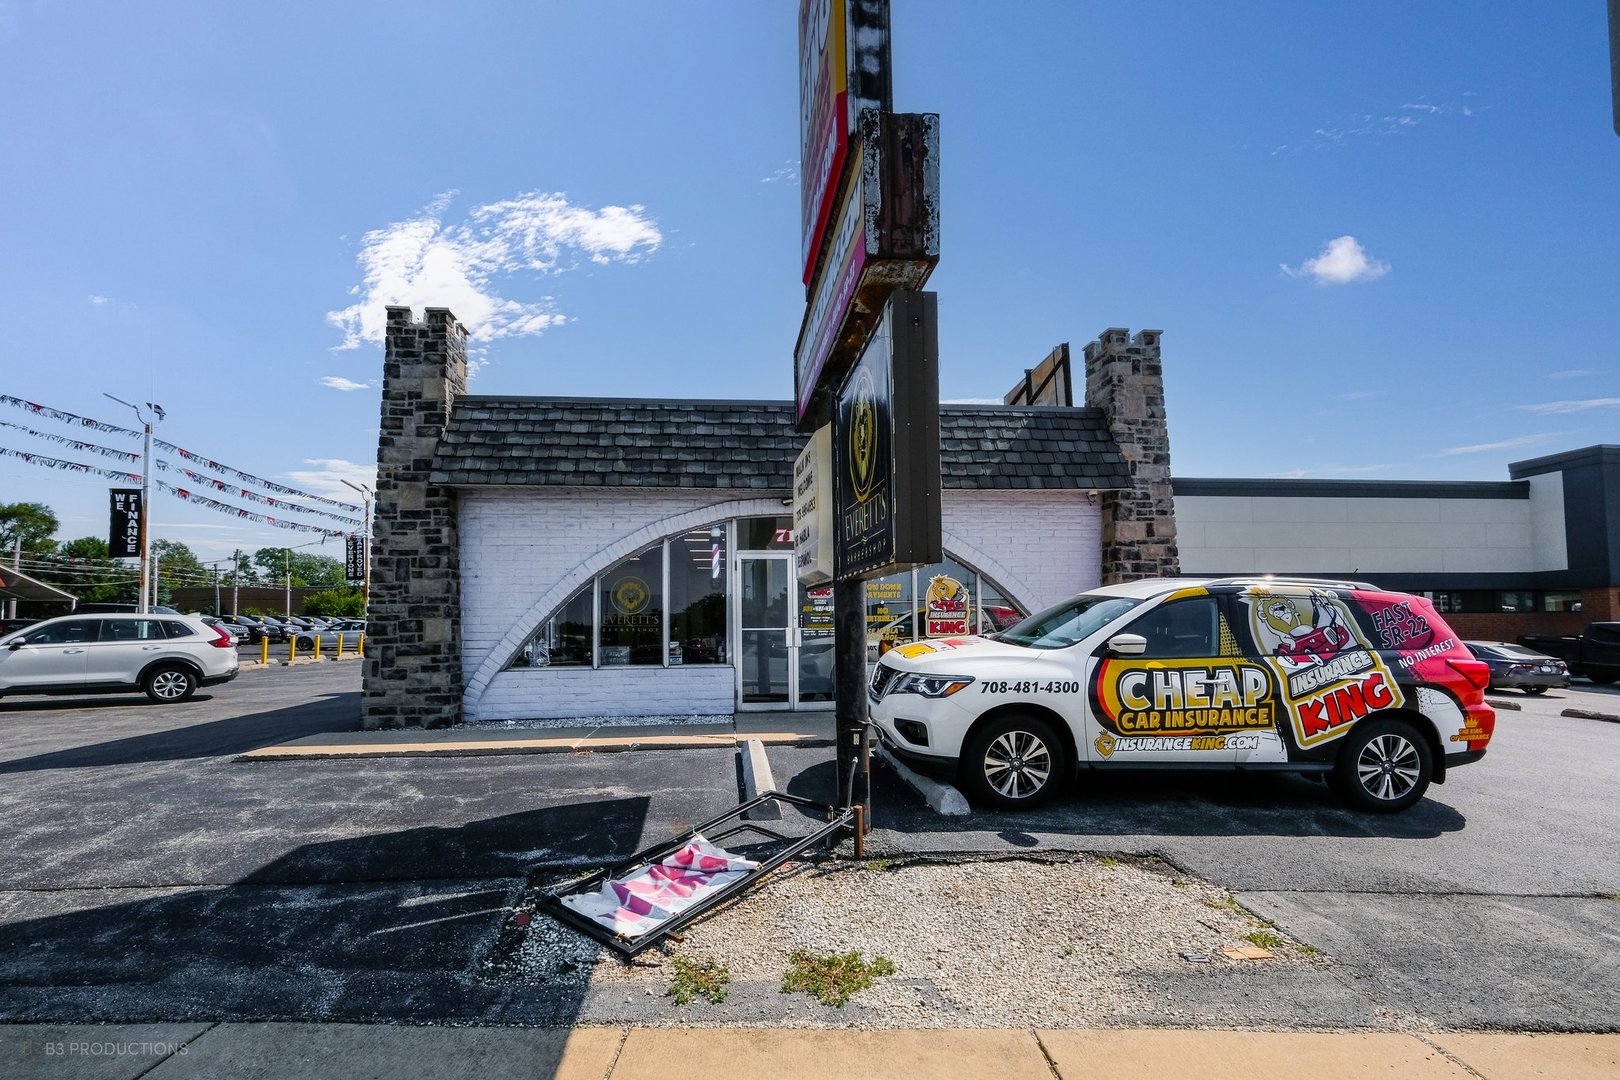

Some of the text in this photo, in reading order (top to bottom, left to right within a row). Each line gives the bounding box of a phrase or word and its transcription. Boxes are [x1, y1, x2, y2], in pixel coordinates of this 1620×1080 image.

[798, 470, 813, 498] WELCOME
[115, 494, 126, 510] WE
[845, 487, 886, 541] EVERETT'S
[127, 494, 139, 552] FINANCE
[347, 541, 355, 577] EVERYONE
[847, 538, 886, 565] BARBERSHOP
[879, 583, 902, 591] DOWN
[603, 615, 660, 625] EVERETT'S
[929, 611, 967, 619] INSURANCE
[929, 621, 966, 634] KING
[1371, 600, 1413, 631] FAST
[1380, 615, 1431, 648] SR-22
[1398, 638, 1455, 669] NO INTEREST
[1290, 650, 1373, 697] INSURANCE
[980, 681, 1080, 694] 708-481-4300
[1119, 668, 1267, 711] CHEAP
[1121, 707, 1269, 729] CAR INSURANCE
[1298, 673, 1393, 737] KING
[1114, 736, 1259, 751] INSURANCEKING.COM
[1450, 733, 1489, 742] OF INSURANCE
